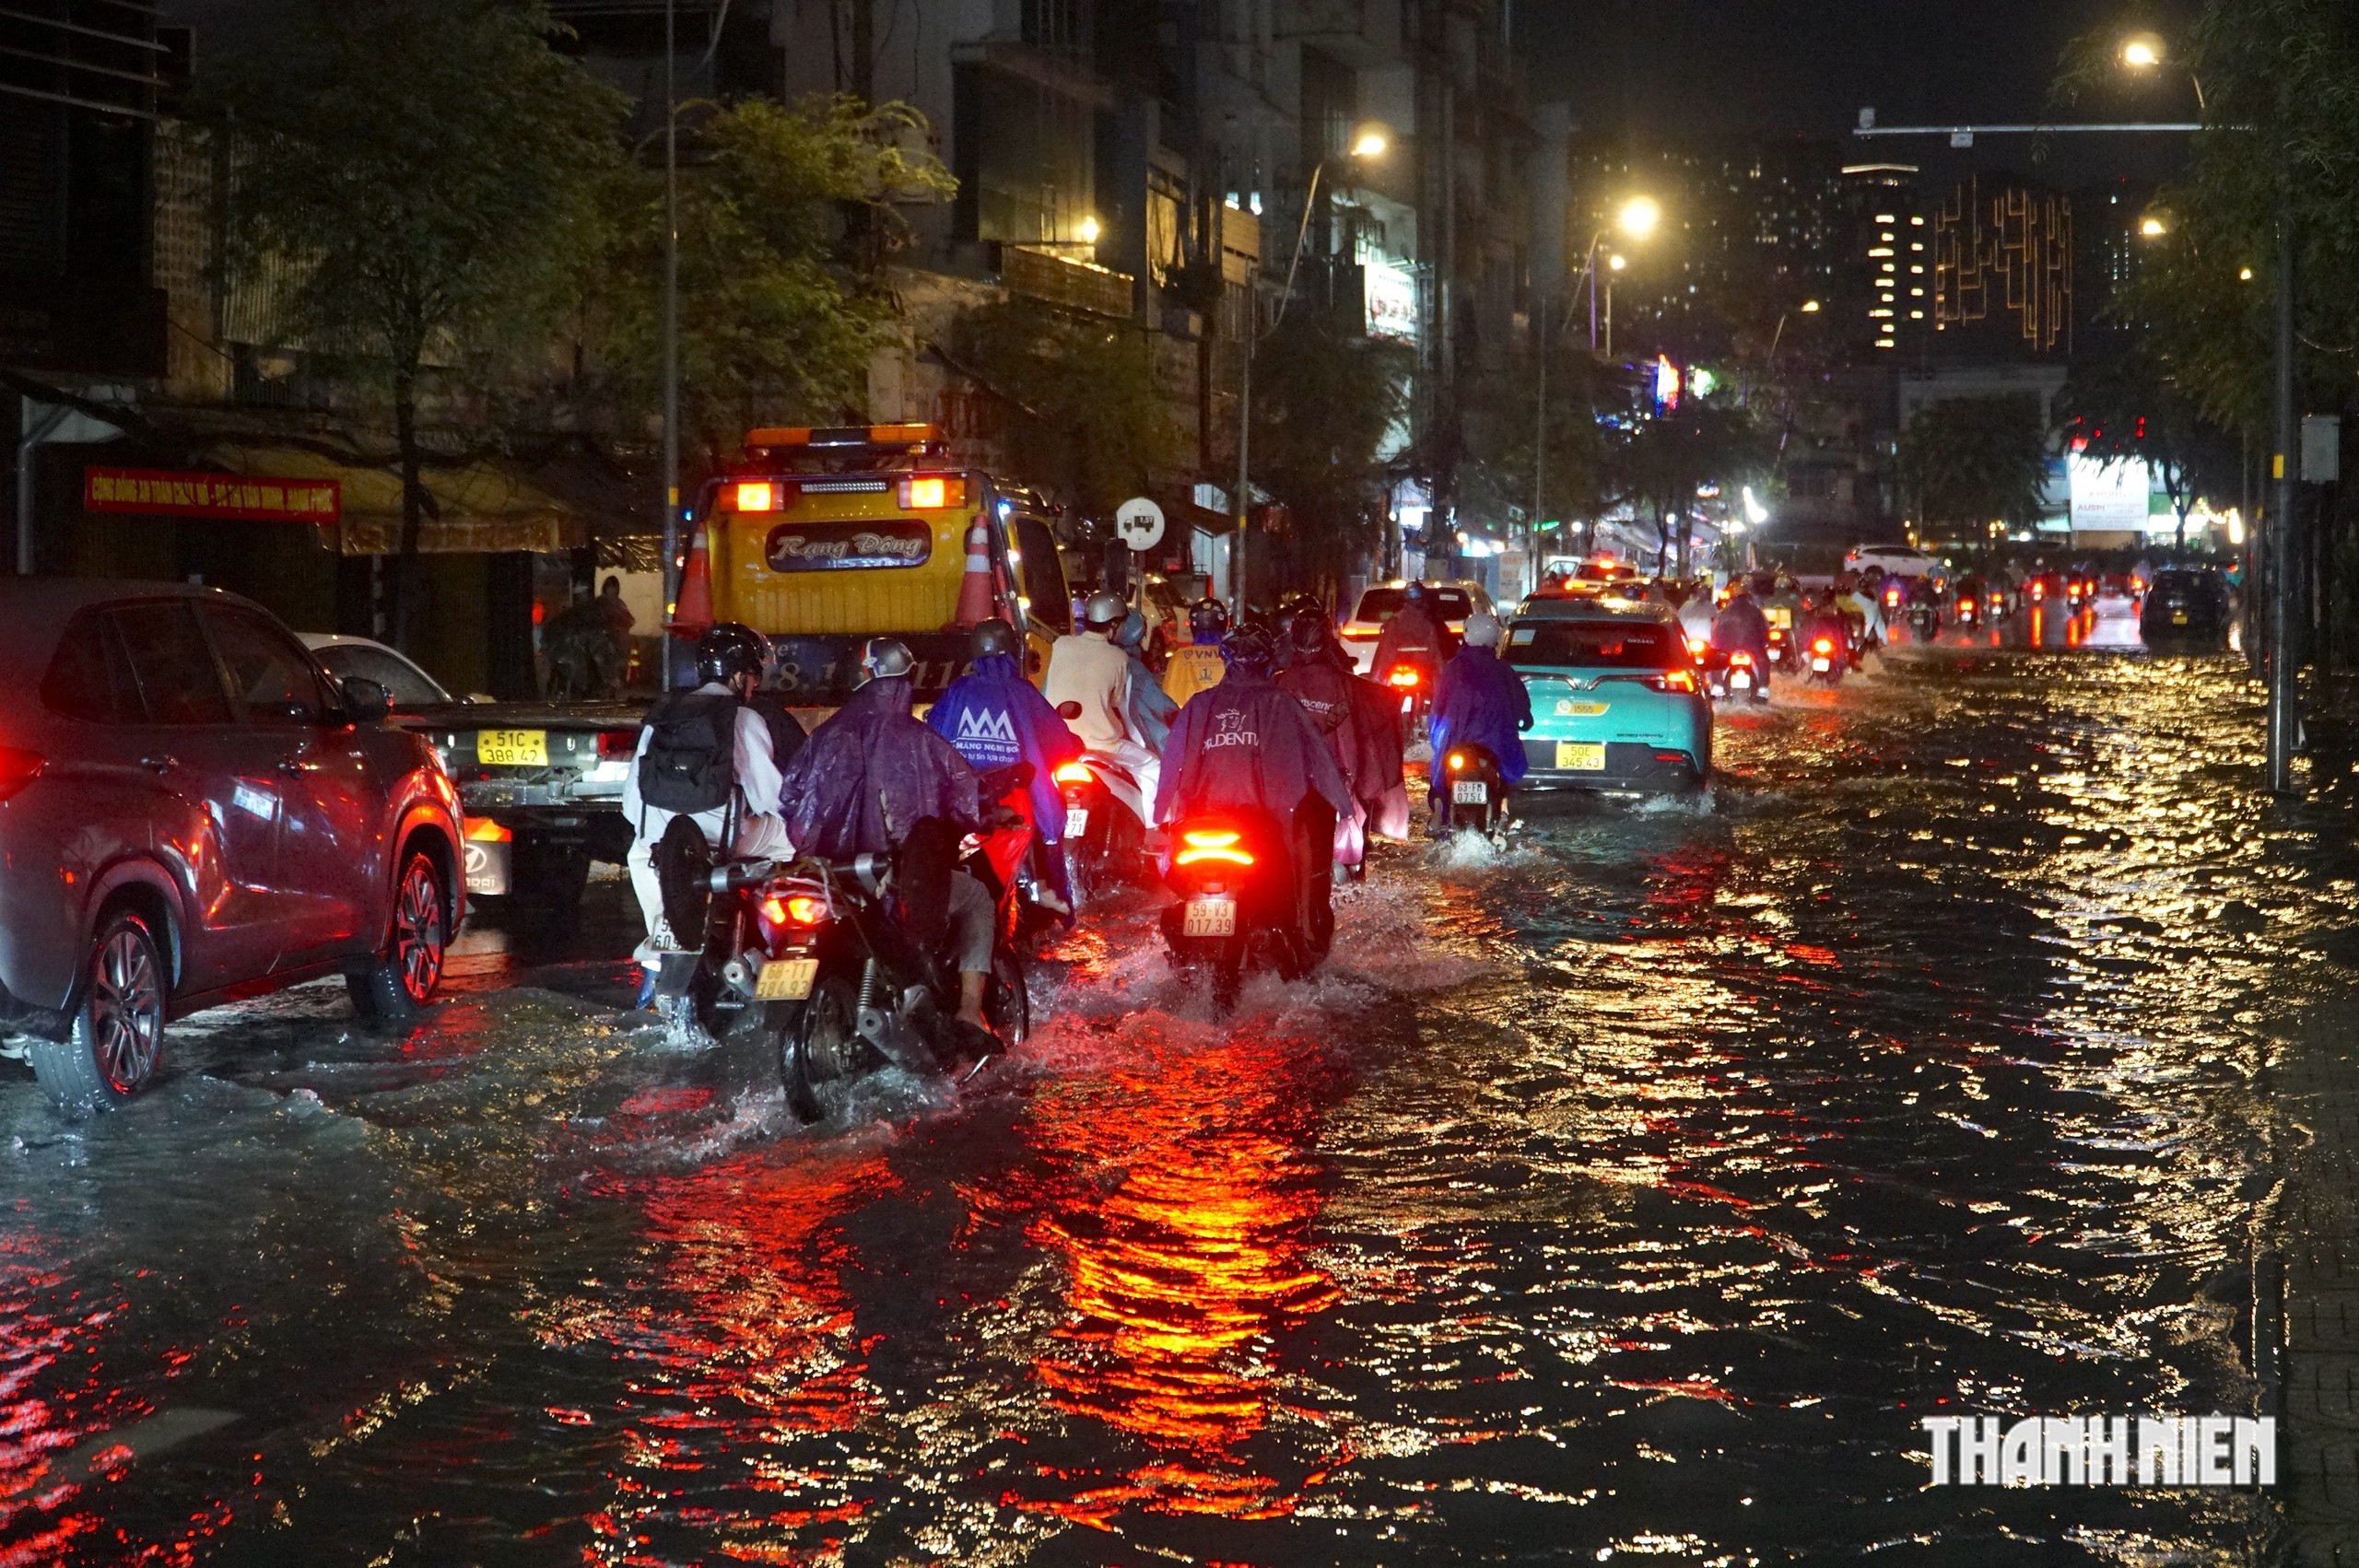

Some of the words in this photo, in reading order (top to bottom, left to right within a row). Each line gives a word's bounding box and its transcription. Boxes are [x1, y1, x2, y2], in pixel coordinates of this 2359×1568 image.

[777, 535, 849, 560] Rạng
[852, 532, 922, 558] Đông
[1195, 650, 1219, 659] VNV
[1573, 705, 1594, 714] 1555
[497, 731, 525, 747] 51C
[1006, 745, 1019, 754] SƠ
[1571, 746, 1590, 756] 50E
[1457, 792, 1482, 802] 0754
[1192, 903, 1228, 918] 59-V3
[1187, 919, 1232, 933] 017.39
